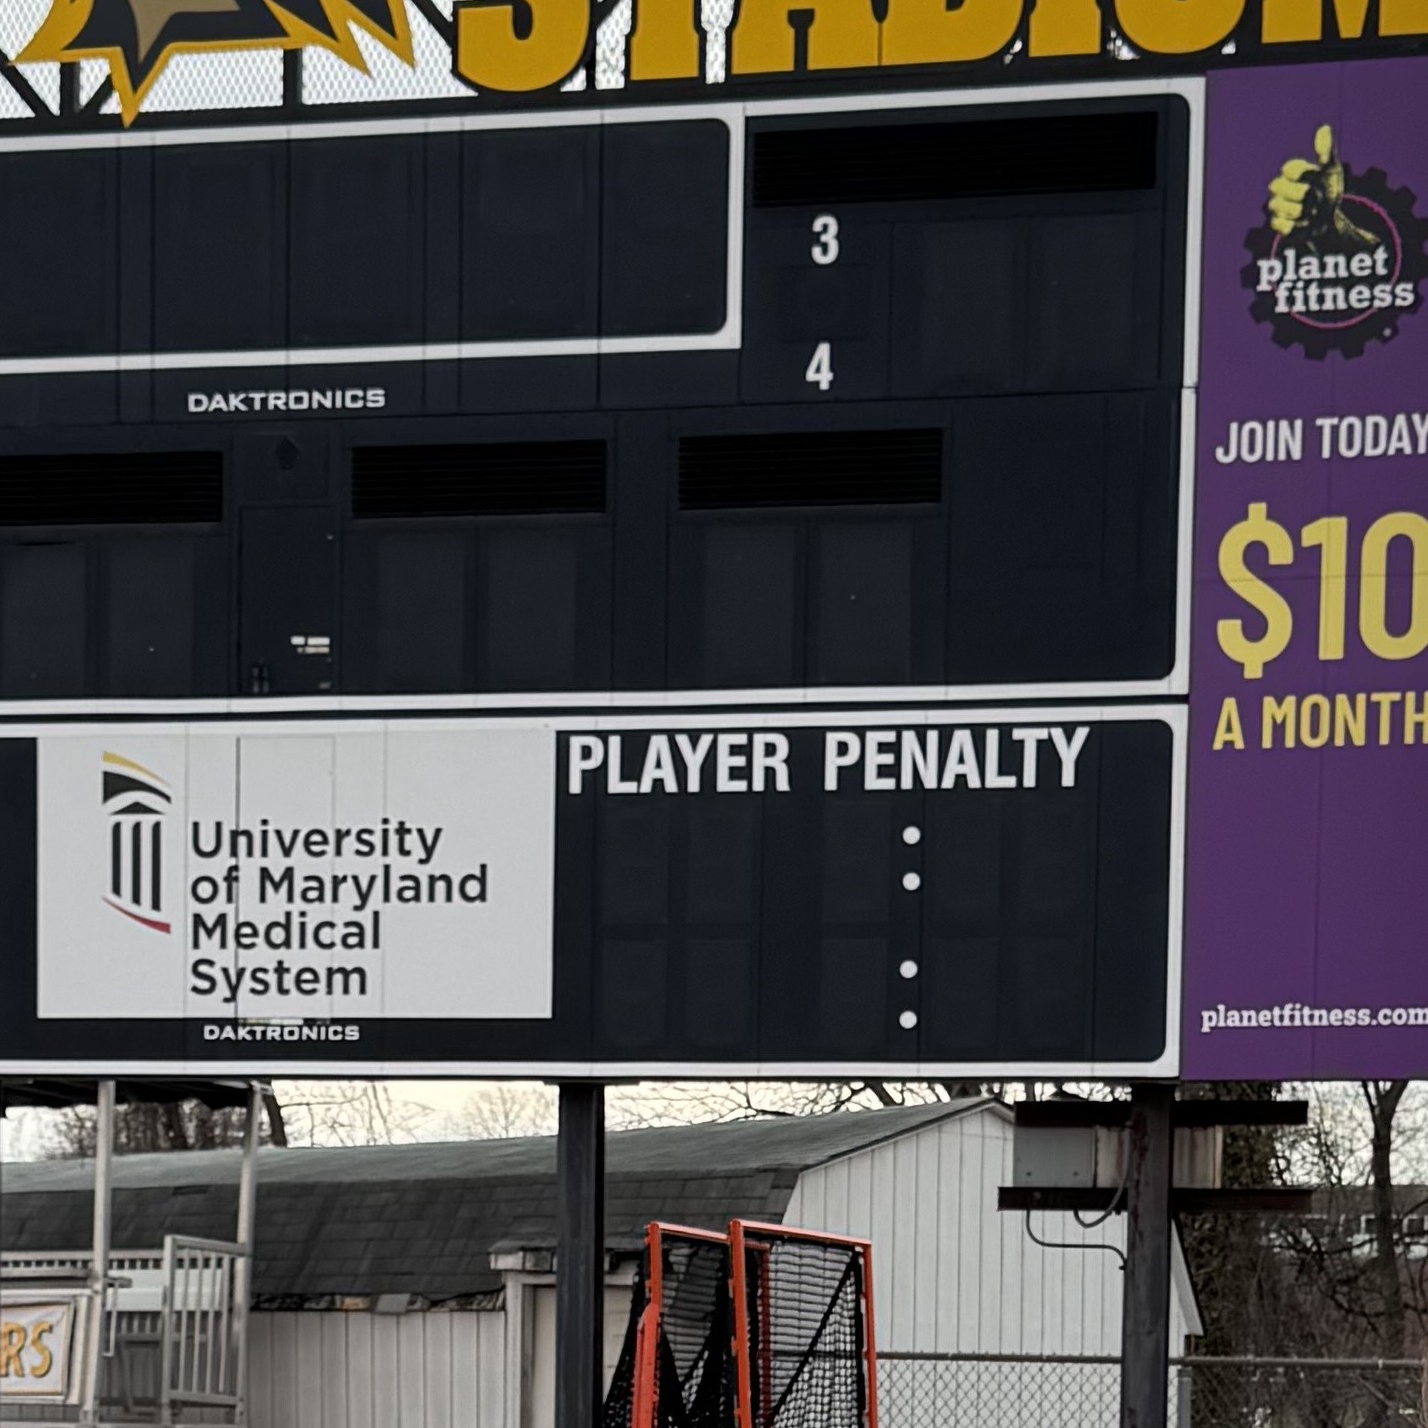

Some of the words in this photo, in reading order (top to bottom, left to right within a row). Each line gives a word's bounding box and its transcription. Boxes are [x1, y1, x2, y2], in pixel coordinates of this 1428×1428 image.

[811, 215, 840, 266] 3
[1256, 243, 1389, 292] planet
[1274, 281, 1416, 314] fitness
[805, 340, 835, 391] 4
[187, 388, 386, 413] DAKTRONICS
[1215, 417, 1303, 464] JOIN
[1212, 696, 1246, 751] A
[568, 732, 791, 795] PLAYER
[823, 726, 1090, 791] PENALTY
[191, 818, 443, 865] University
[190, 865, 240, 905] of
[259, 863, 489, 911] Maryland
[191, 910, 381, 950] Medical
[189, 957, 368, 1002] System
[202, 1024, 361, 1043] DAKTRONICS
